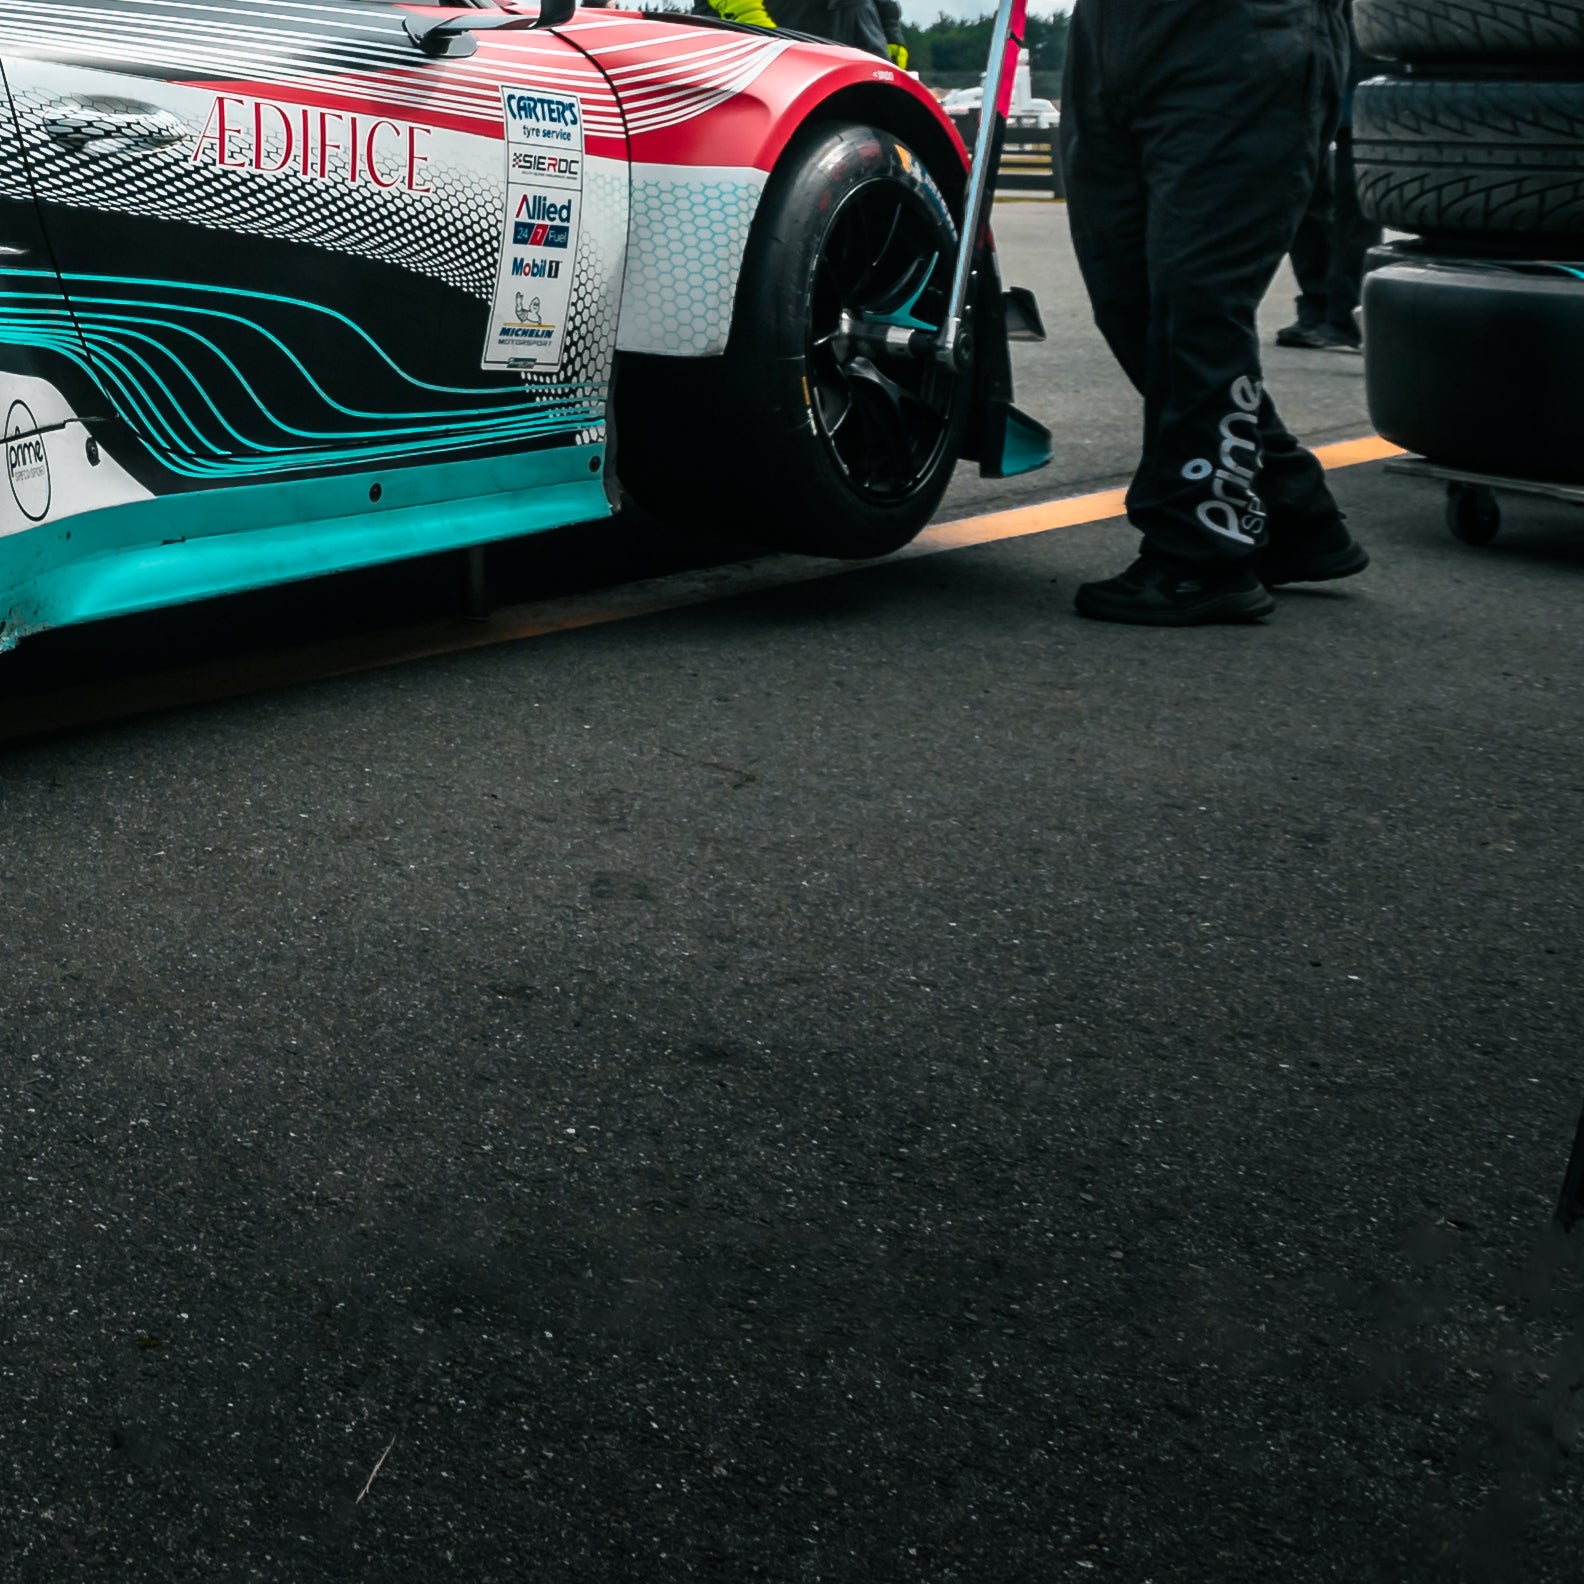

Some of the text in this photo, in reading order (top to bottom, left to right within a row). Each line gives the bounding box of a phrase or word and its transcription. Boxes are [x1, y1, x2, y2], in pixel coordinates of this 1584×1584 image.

[507, 93, 578, 127] CARTER'S
[522, 124, 572, 141] tyre service
[192, 96, 432, 193] ÆDIFICE
[518, 153, 579, 175] SIERDC
[515, 194, 572, 223] Allied
[517, 227, 567, 243] 24 7 Fuel
[512, 257, 547, 277] Mobil
[499, 327, 554, 338] MICHELIN
[1181, 375, 1263, 545] prime
